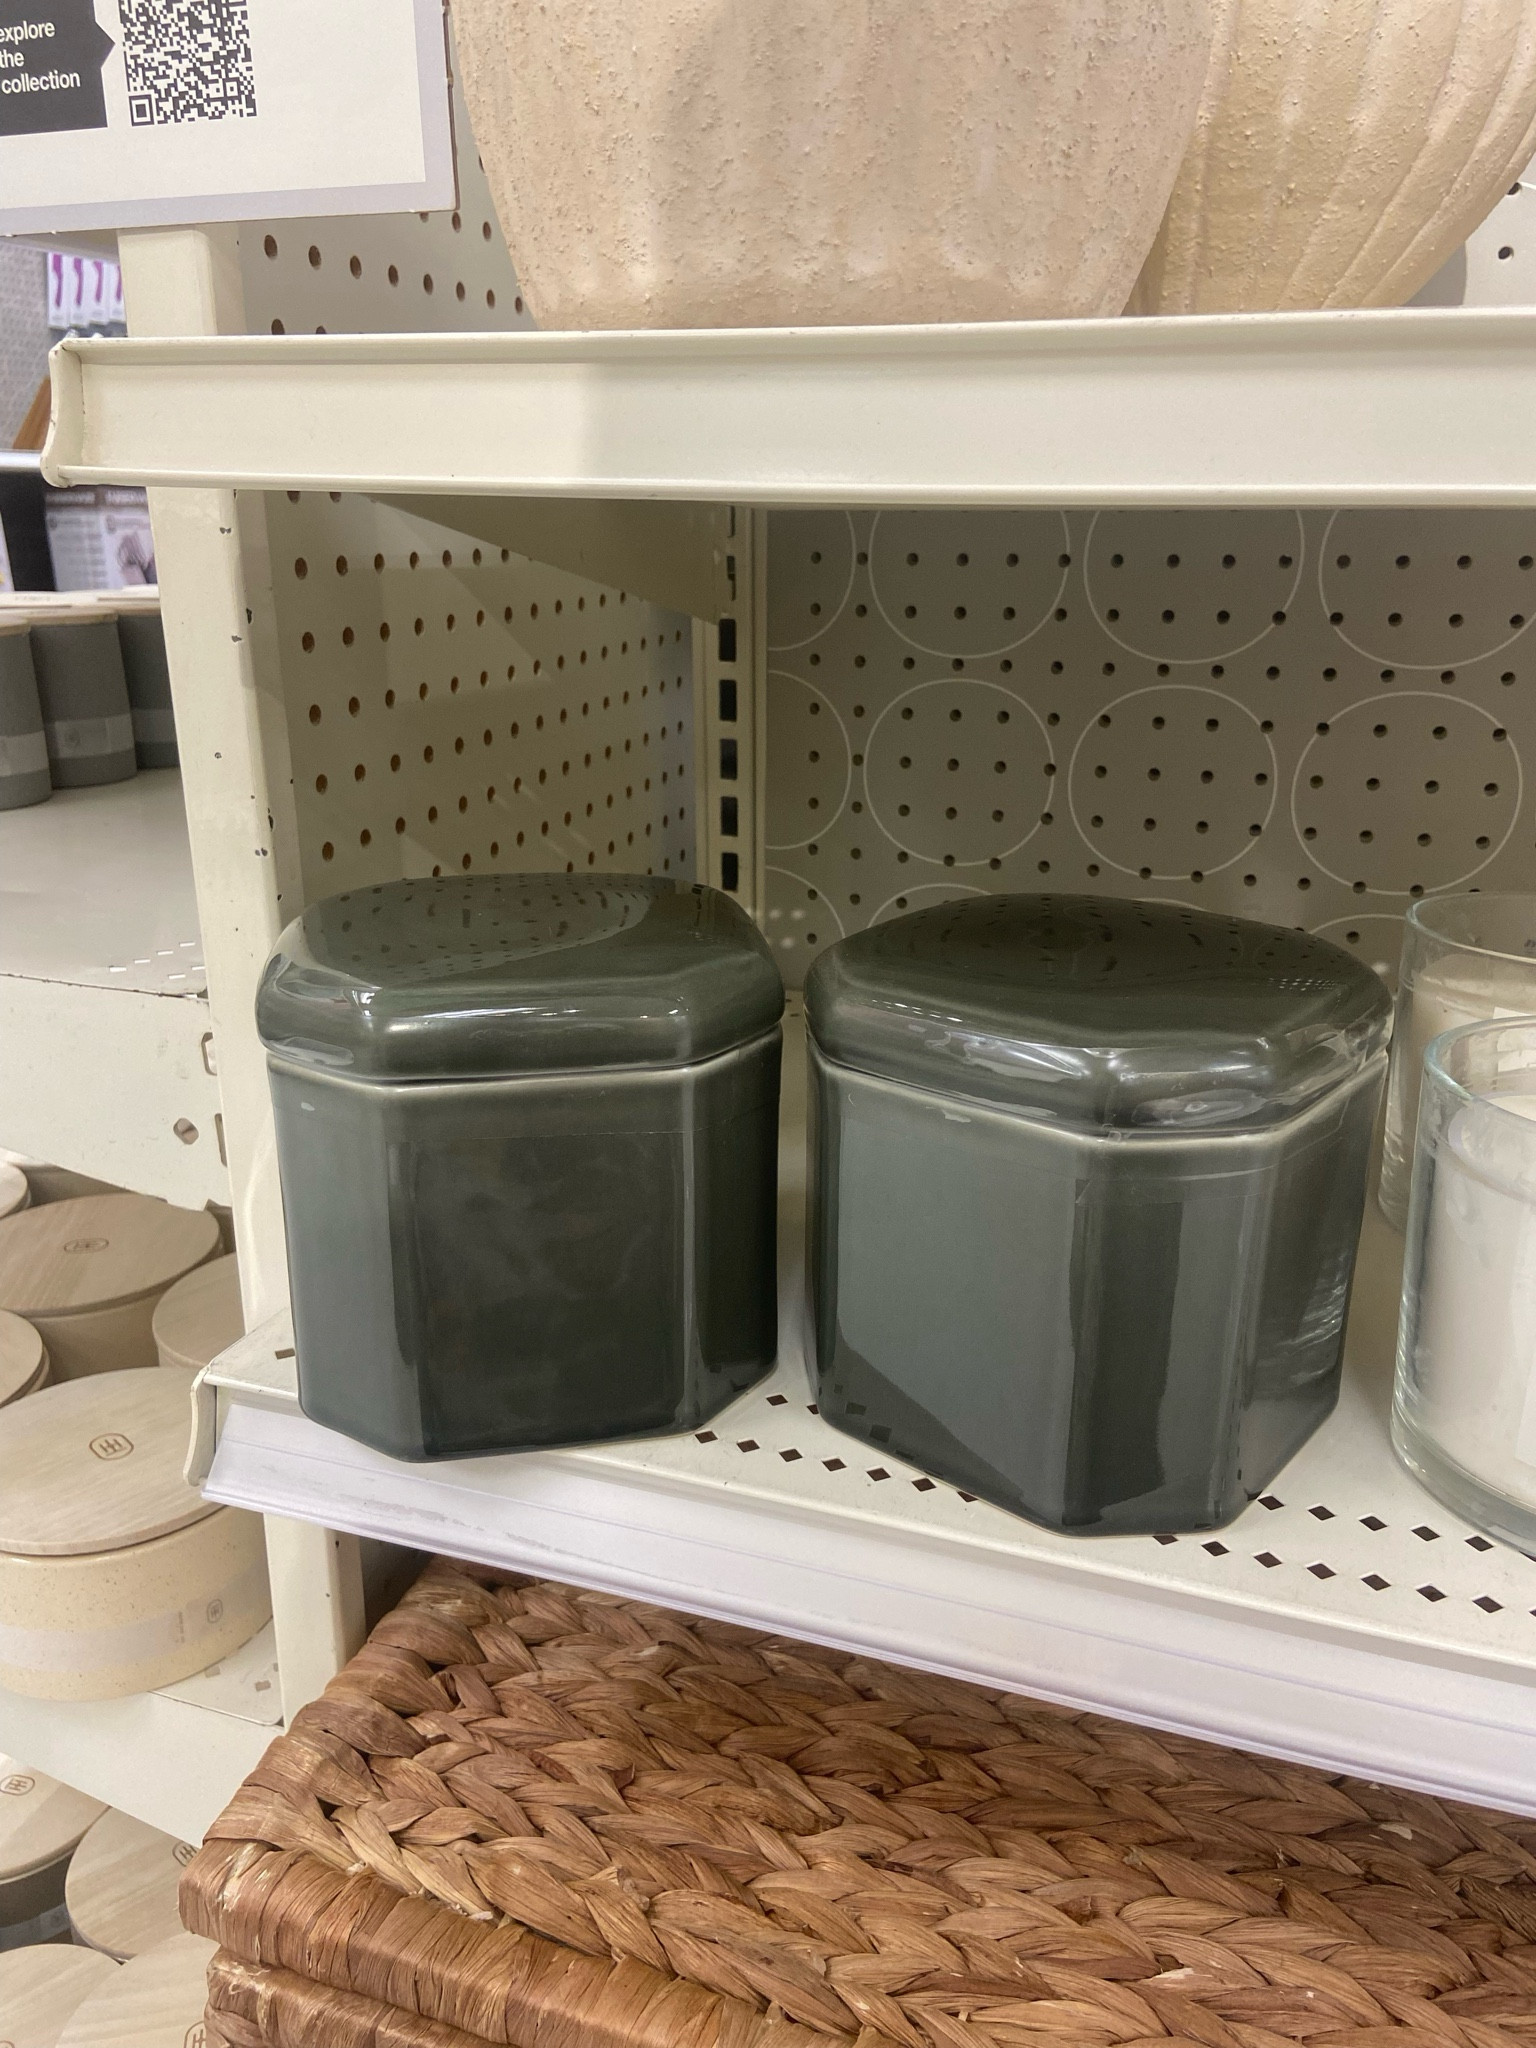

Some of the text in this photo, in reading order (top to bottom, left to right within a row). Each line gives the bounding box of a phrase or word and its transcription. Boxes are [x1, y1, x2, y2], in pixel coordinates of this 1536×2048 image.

[0, 20, 56, 46] explore
[0, 48, 25, 69] the
[1, 69, 81, 95] collection
